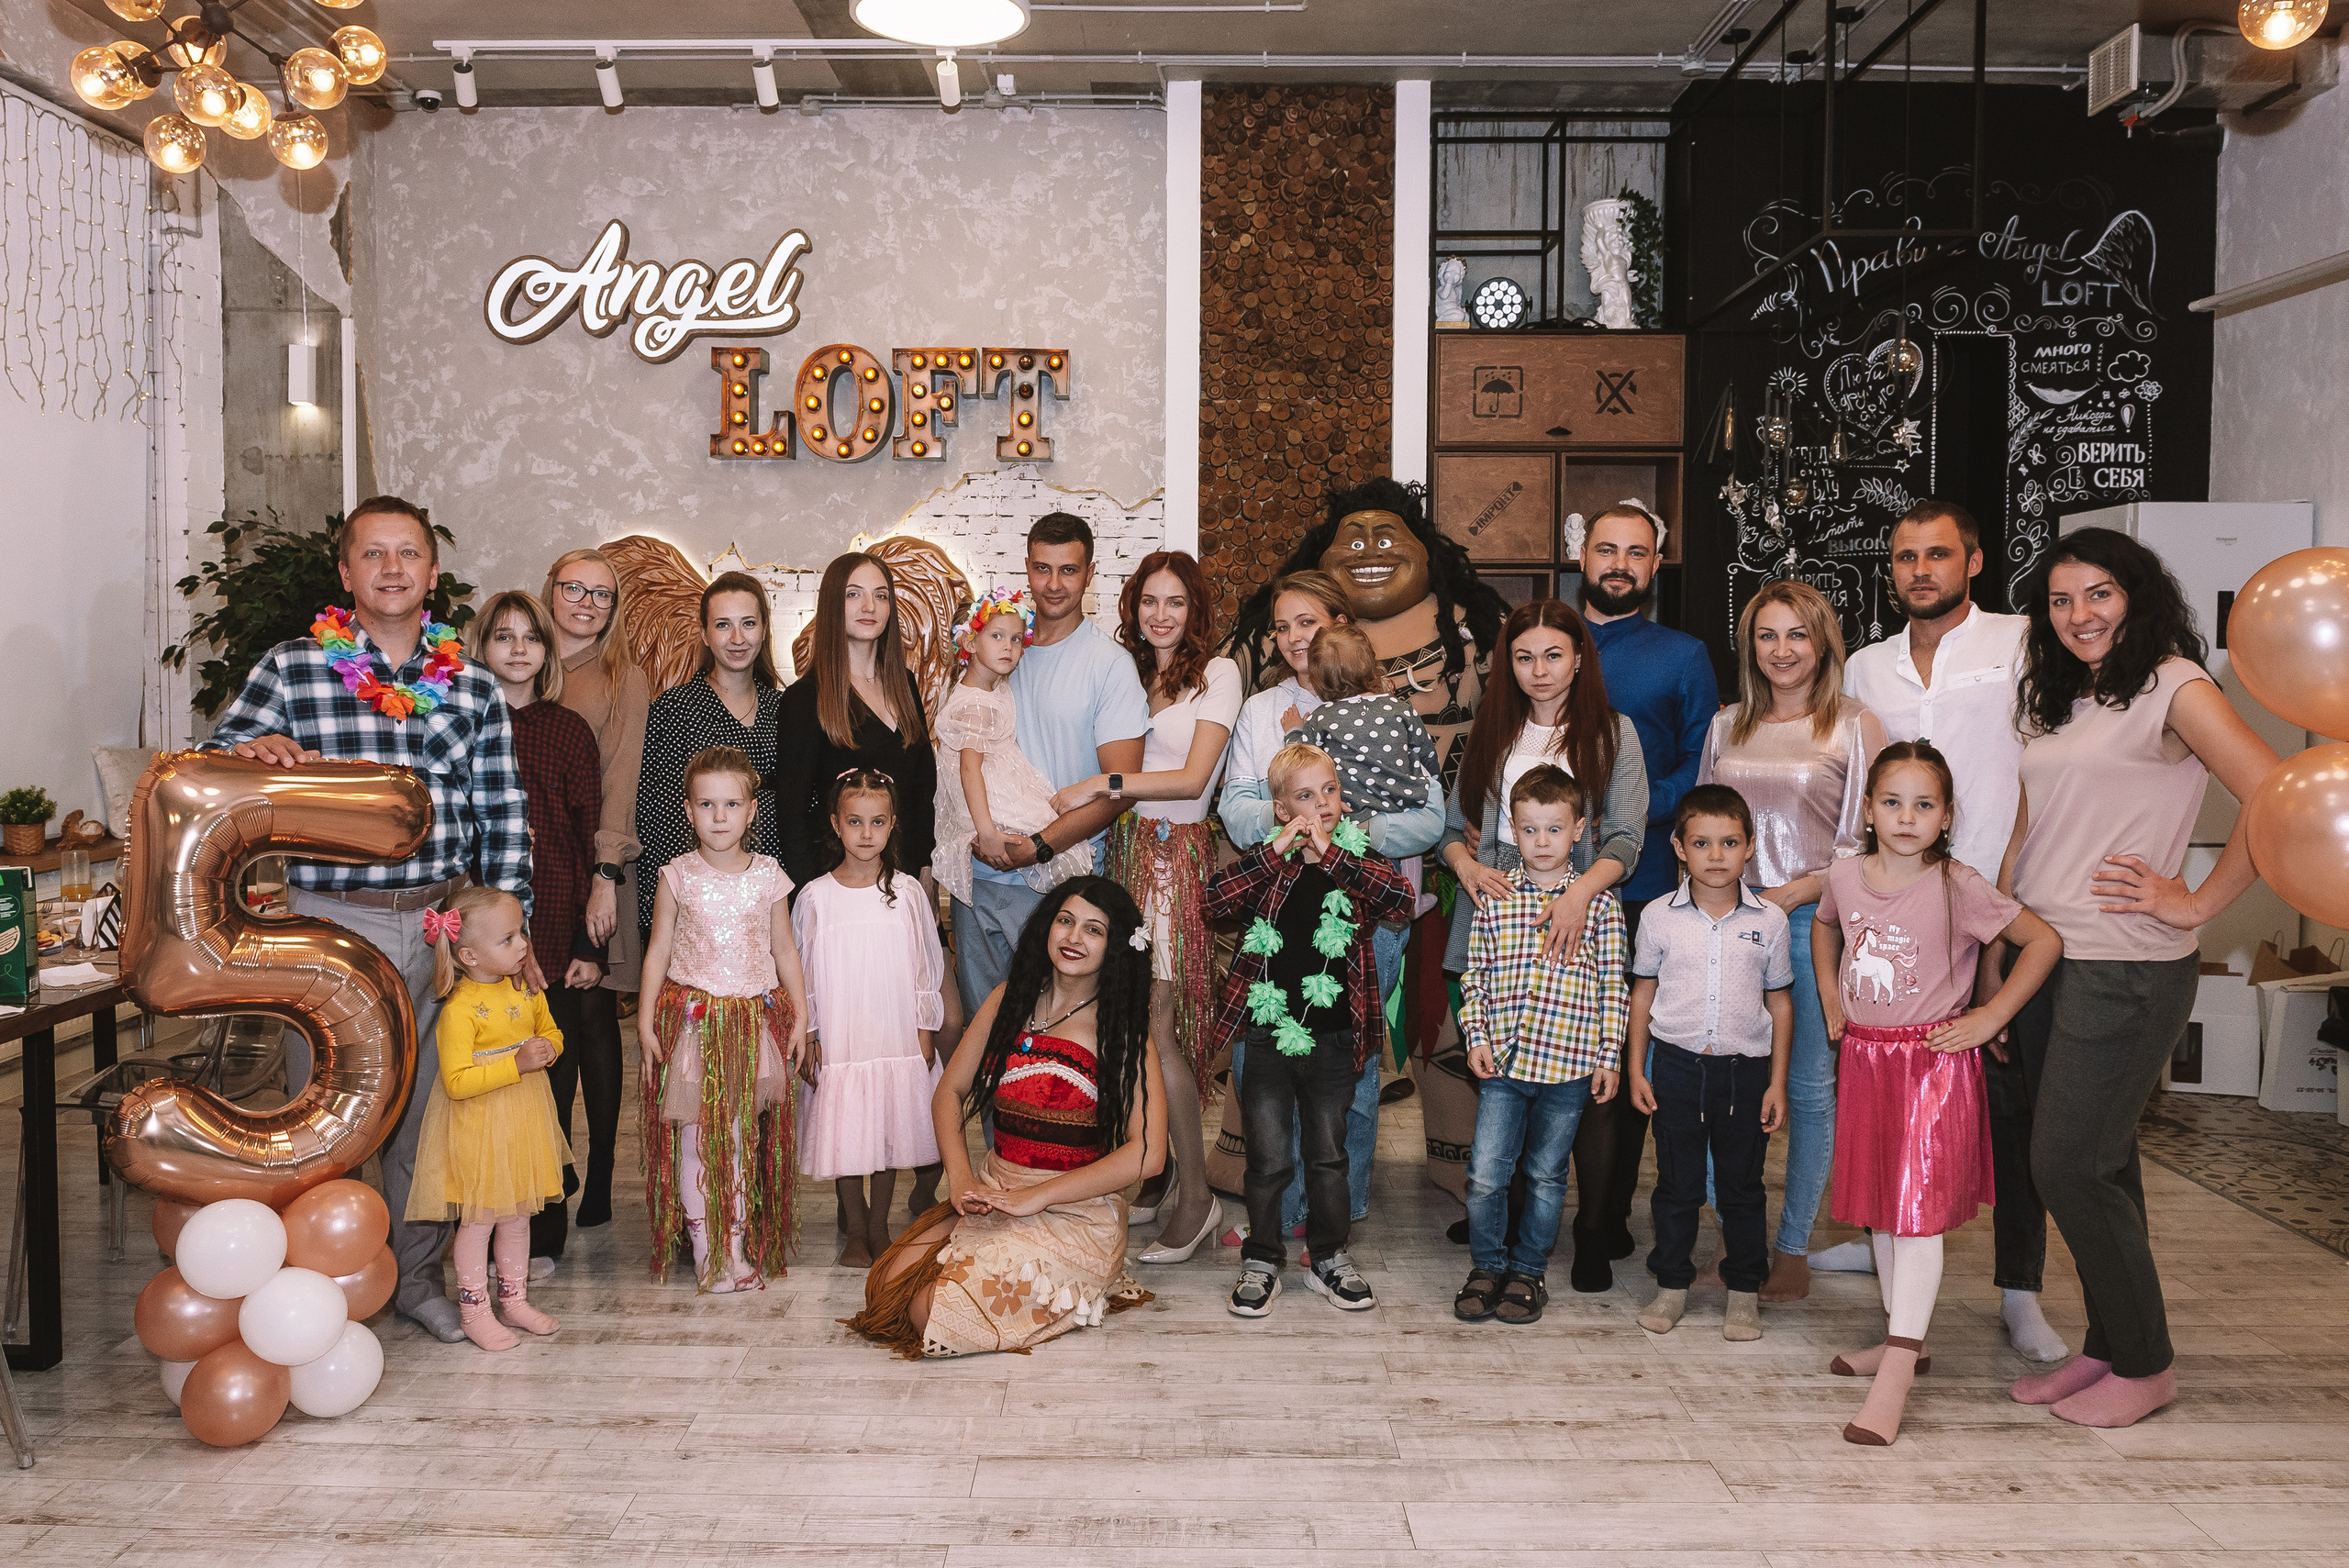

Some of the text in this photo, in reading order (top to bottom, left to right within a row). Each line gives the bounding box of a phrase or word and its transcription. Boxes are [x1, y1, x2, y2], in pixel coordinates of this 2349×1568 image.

[1979, 215, 2083, 284] Angel
[484, 219, 812, 363] Angel
[2042, 280, 2120, 307] LOFT
[2021, 359, 2090, 374] СМЕЯТЬСЯ
[709, 344, 1070, 462] LOFT
[2078, 442, 2146, 463] ВЕРИТЬ
[2093, 467, 2144, 488] СЕБЯ
[1475, 486, 1516, 529] IMPORT
[1887, 934, 1910, 943] magic
[1888, 924, 1901, 934] My
[1879, 942, 1900, 951] space
[104, 748, 435, 1208] 5
